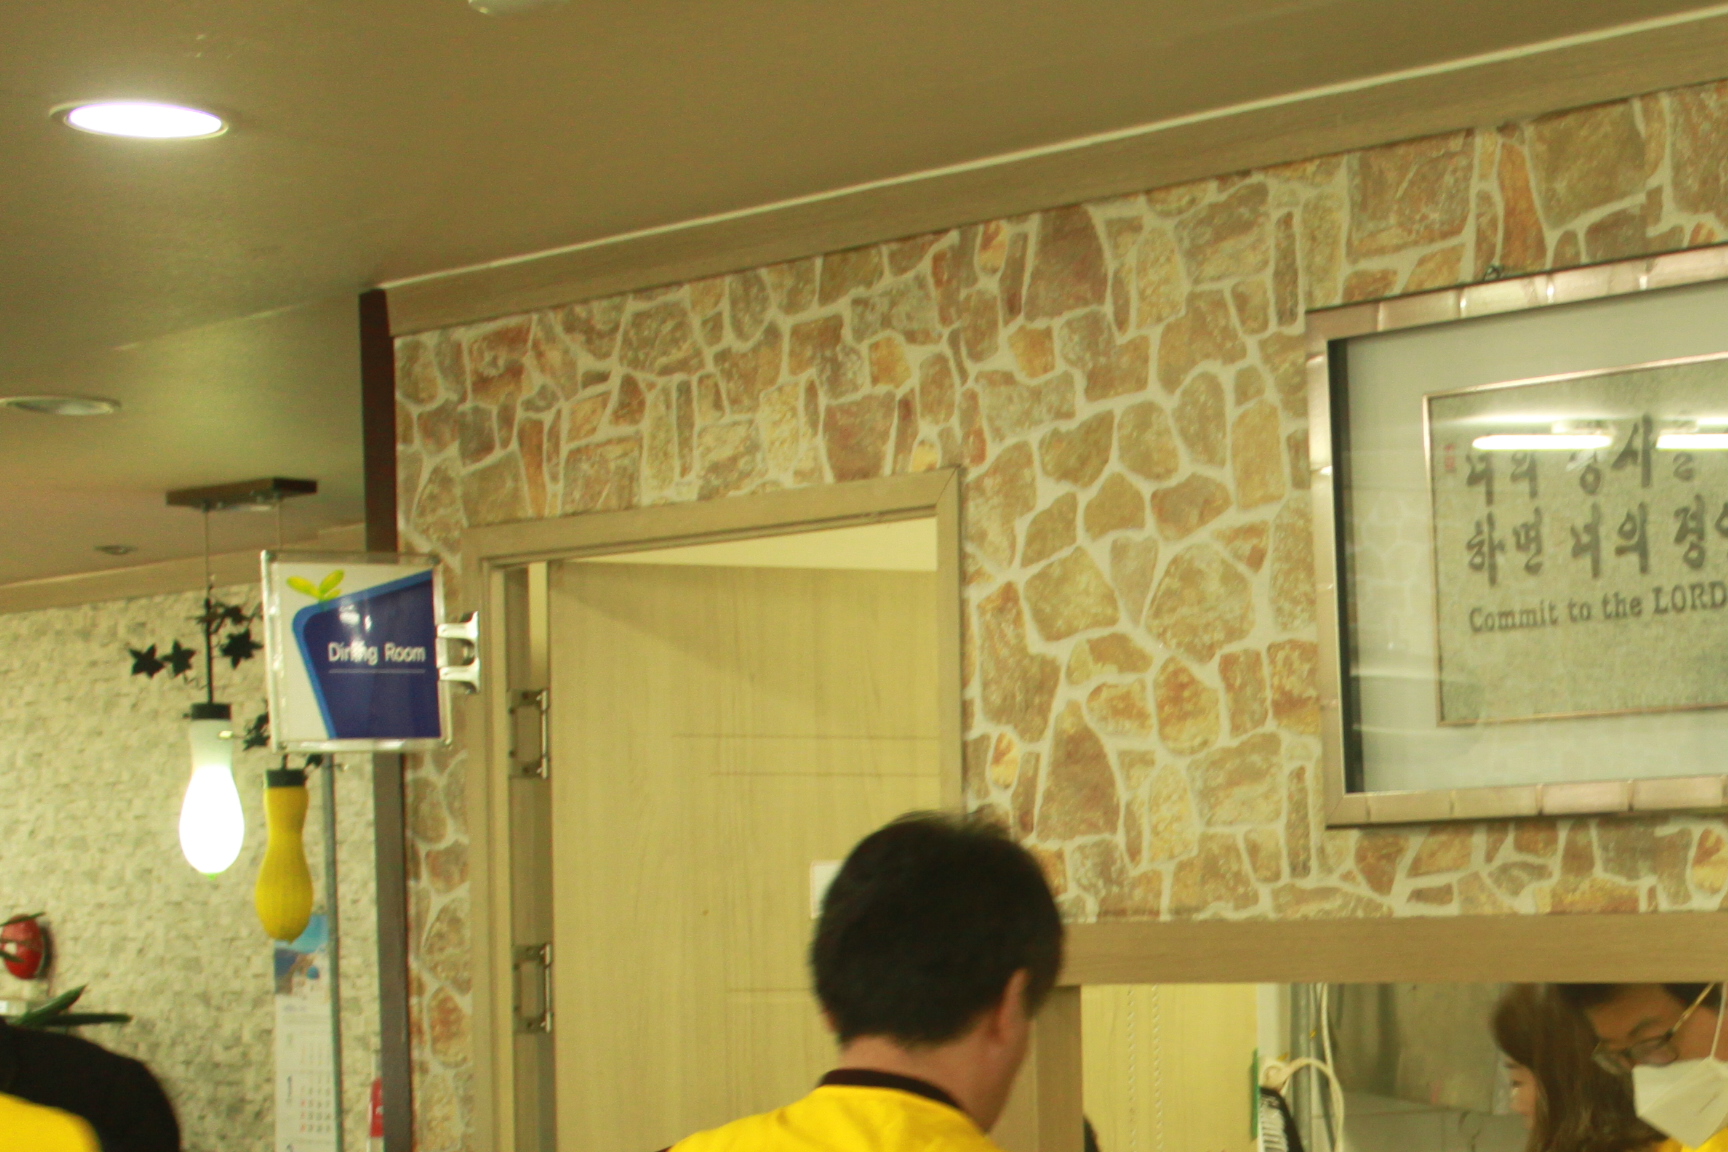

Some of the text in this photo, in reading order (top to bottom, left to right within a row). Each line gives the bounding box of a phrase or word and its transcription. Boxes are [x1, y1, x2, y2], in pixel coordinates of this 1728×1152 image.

[1466, 506, 1544, 588] 하면
[1571, 501, 1649, 580] 너의
[1469, 598, 1558, 634] Commit
[1568, 598, 1592, 622] to
[1601, 591, 1643, 620] the
[1651, 580, 1728, 616] LORD
[385, 641, 426, 663] Room
